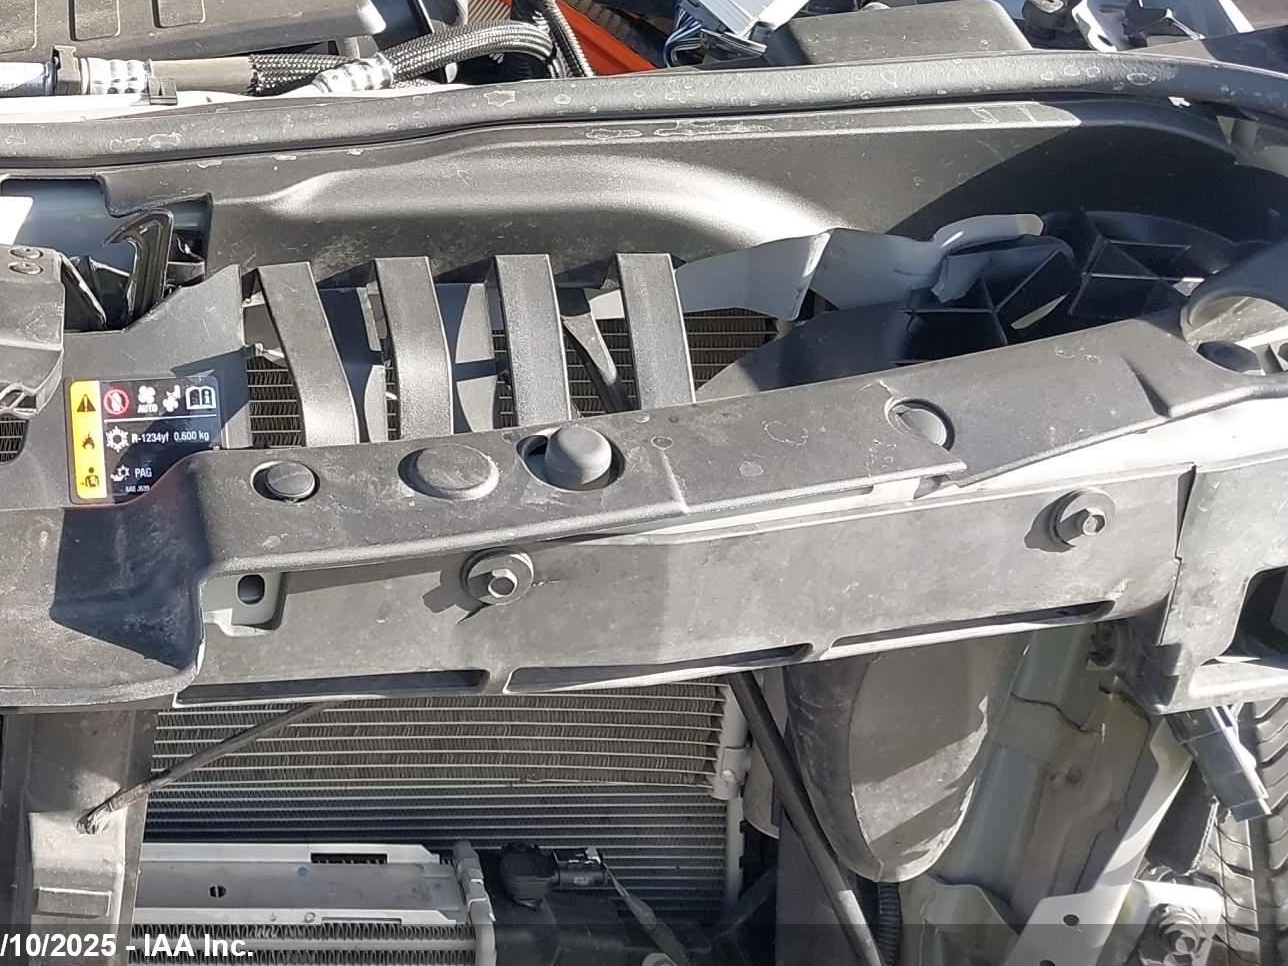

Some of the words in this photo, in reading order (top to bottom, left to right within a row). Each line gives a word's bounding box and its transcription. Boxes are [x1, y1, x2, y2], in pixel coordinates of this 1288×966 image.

[137, 403, 158, 414] AUTO
[131, 433, 169, 444] R-1234yf
[174, 432, 197, 442] 0.600
[198, 431, 210, 441] kg
[134, 467, 153, 478] PAG
